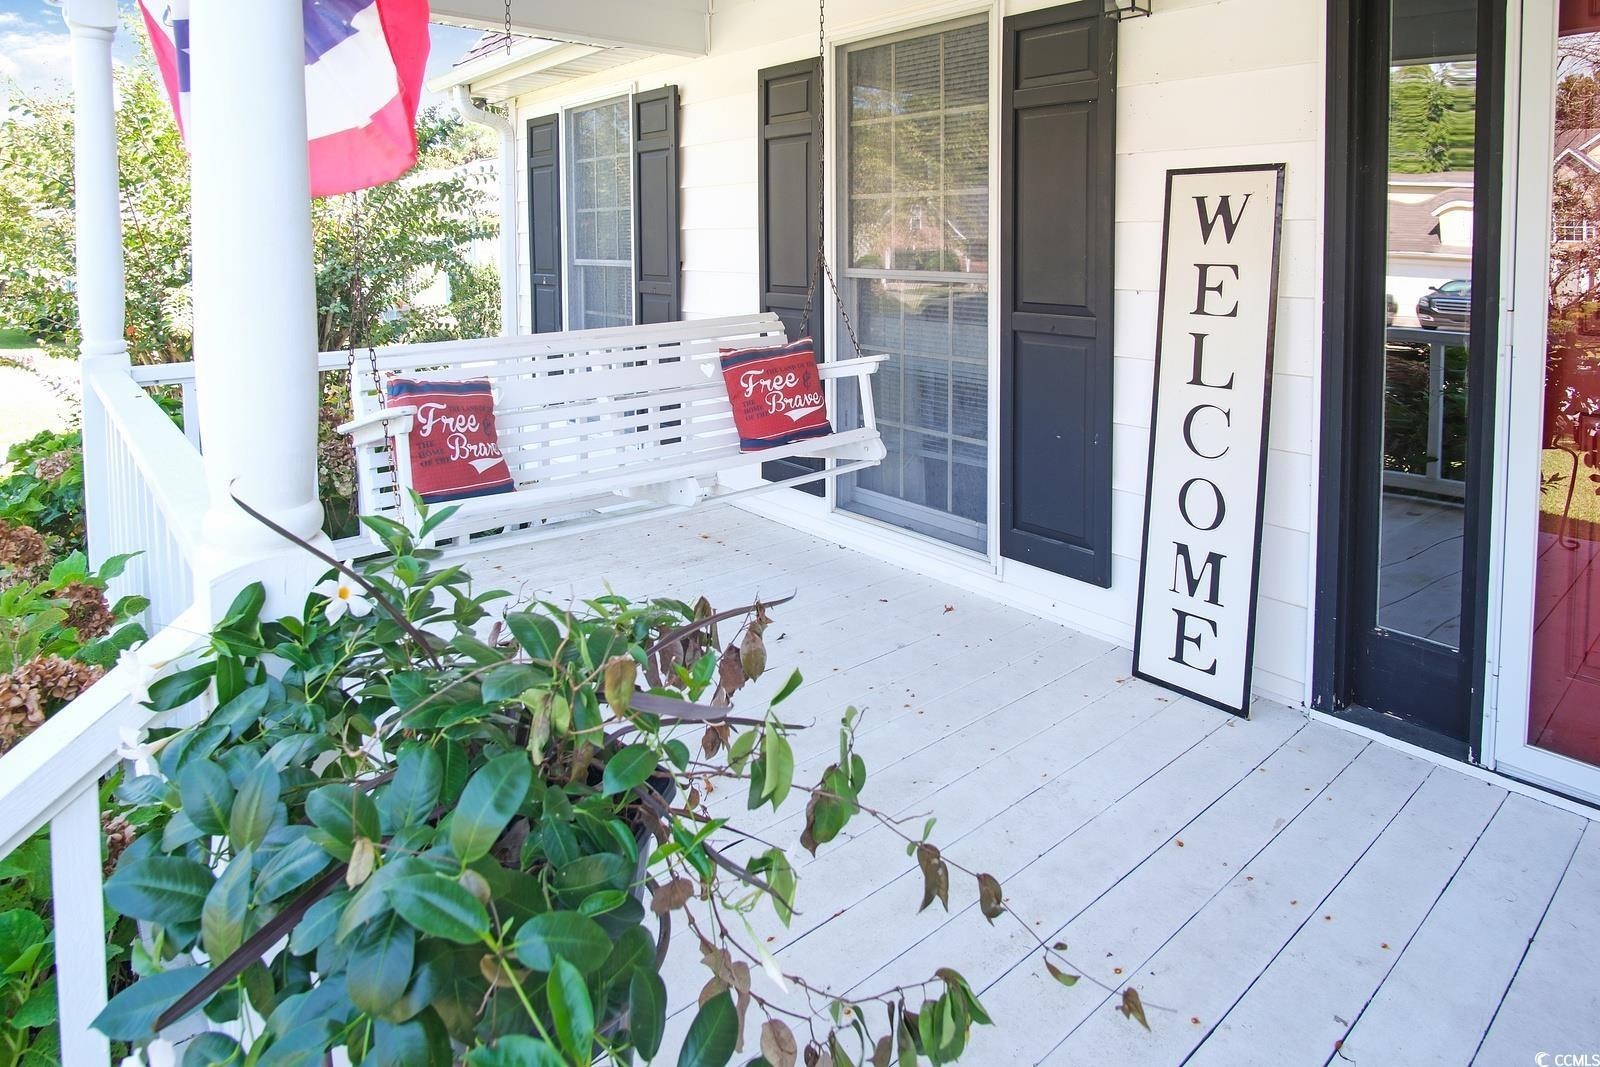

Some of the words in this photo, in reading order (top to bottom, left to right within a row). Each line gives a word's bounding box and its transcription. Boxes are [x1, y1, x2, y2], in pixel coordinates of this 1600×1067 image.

[740, 369, 800, 398] Free
[765, 391, 824, 415] Brave
[417, 402, 480, 437] Free
[1168, 194, 1252, 676] WELCOME
